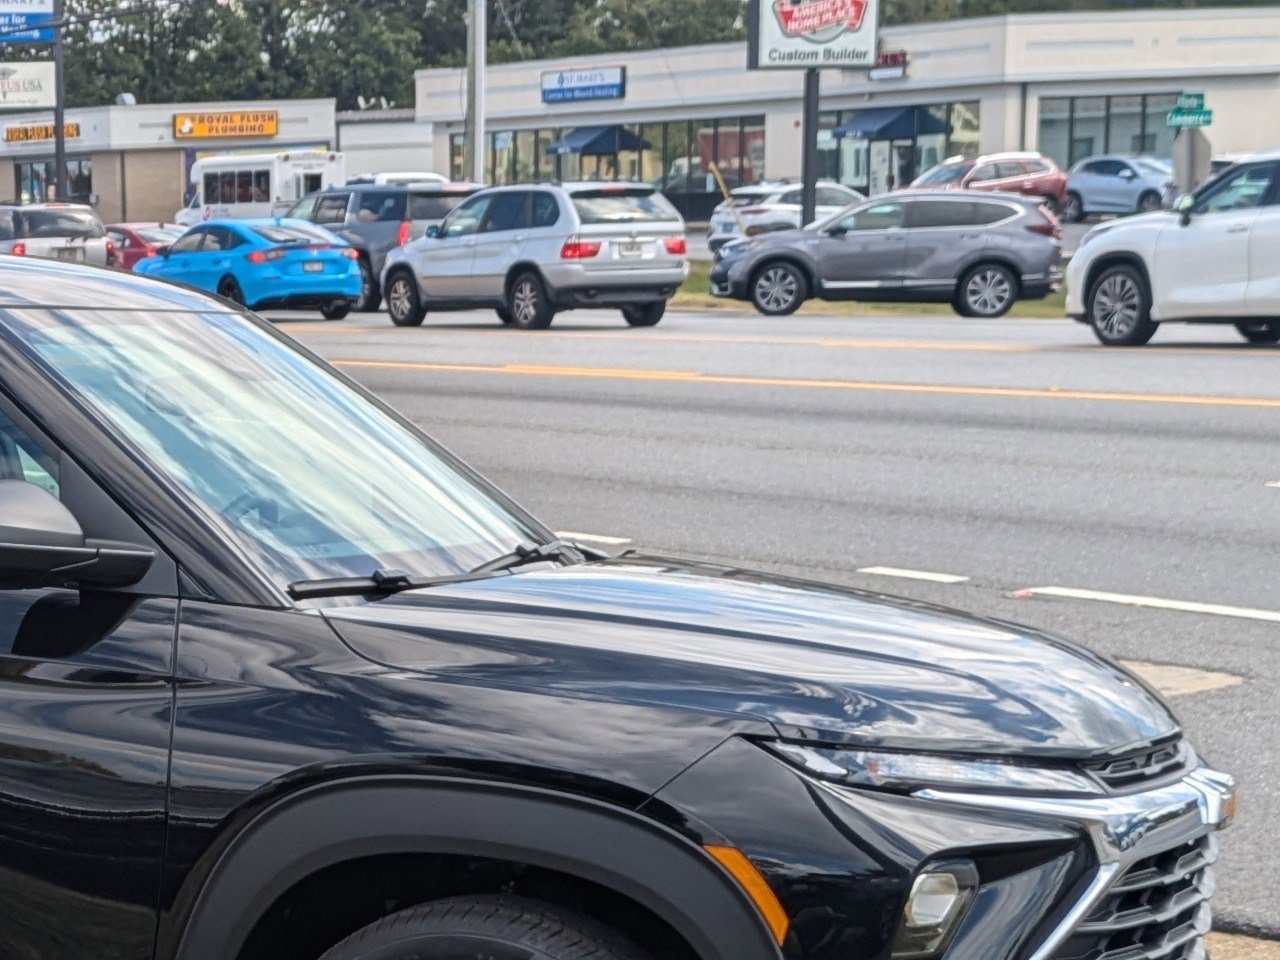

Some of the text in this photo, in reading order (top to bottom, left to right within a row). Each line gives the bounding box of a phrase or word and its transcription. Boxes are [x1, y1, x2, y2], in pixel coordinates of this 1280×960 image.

[11, 14, 26, 24] for
[768, 48, 819, 62] Custom
[822, 47, 868, 61] Builder
[22, 79, 43, 91] USA
[208, 124, 265, 134] PLUMBING
